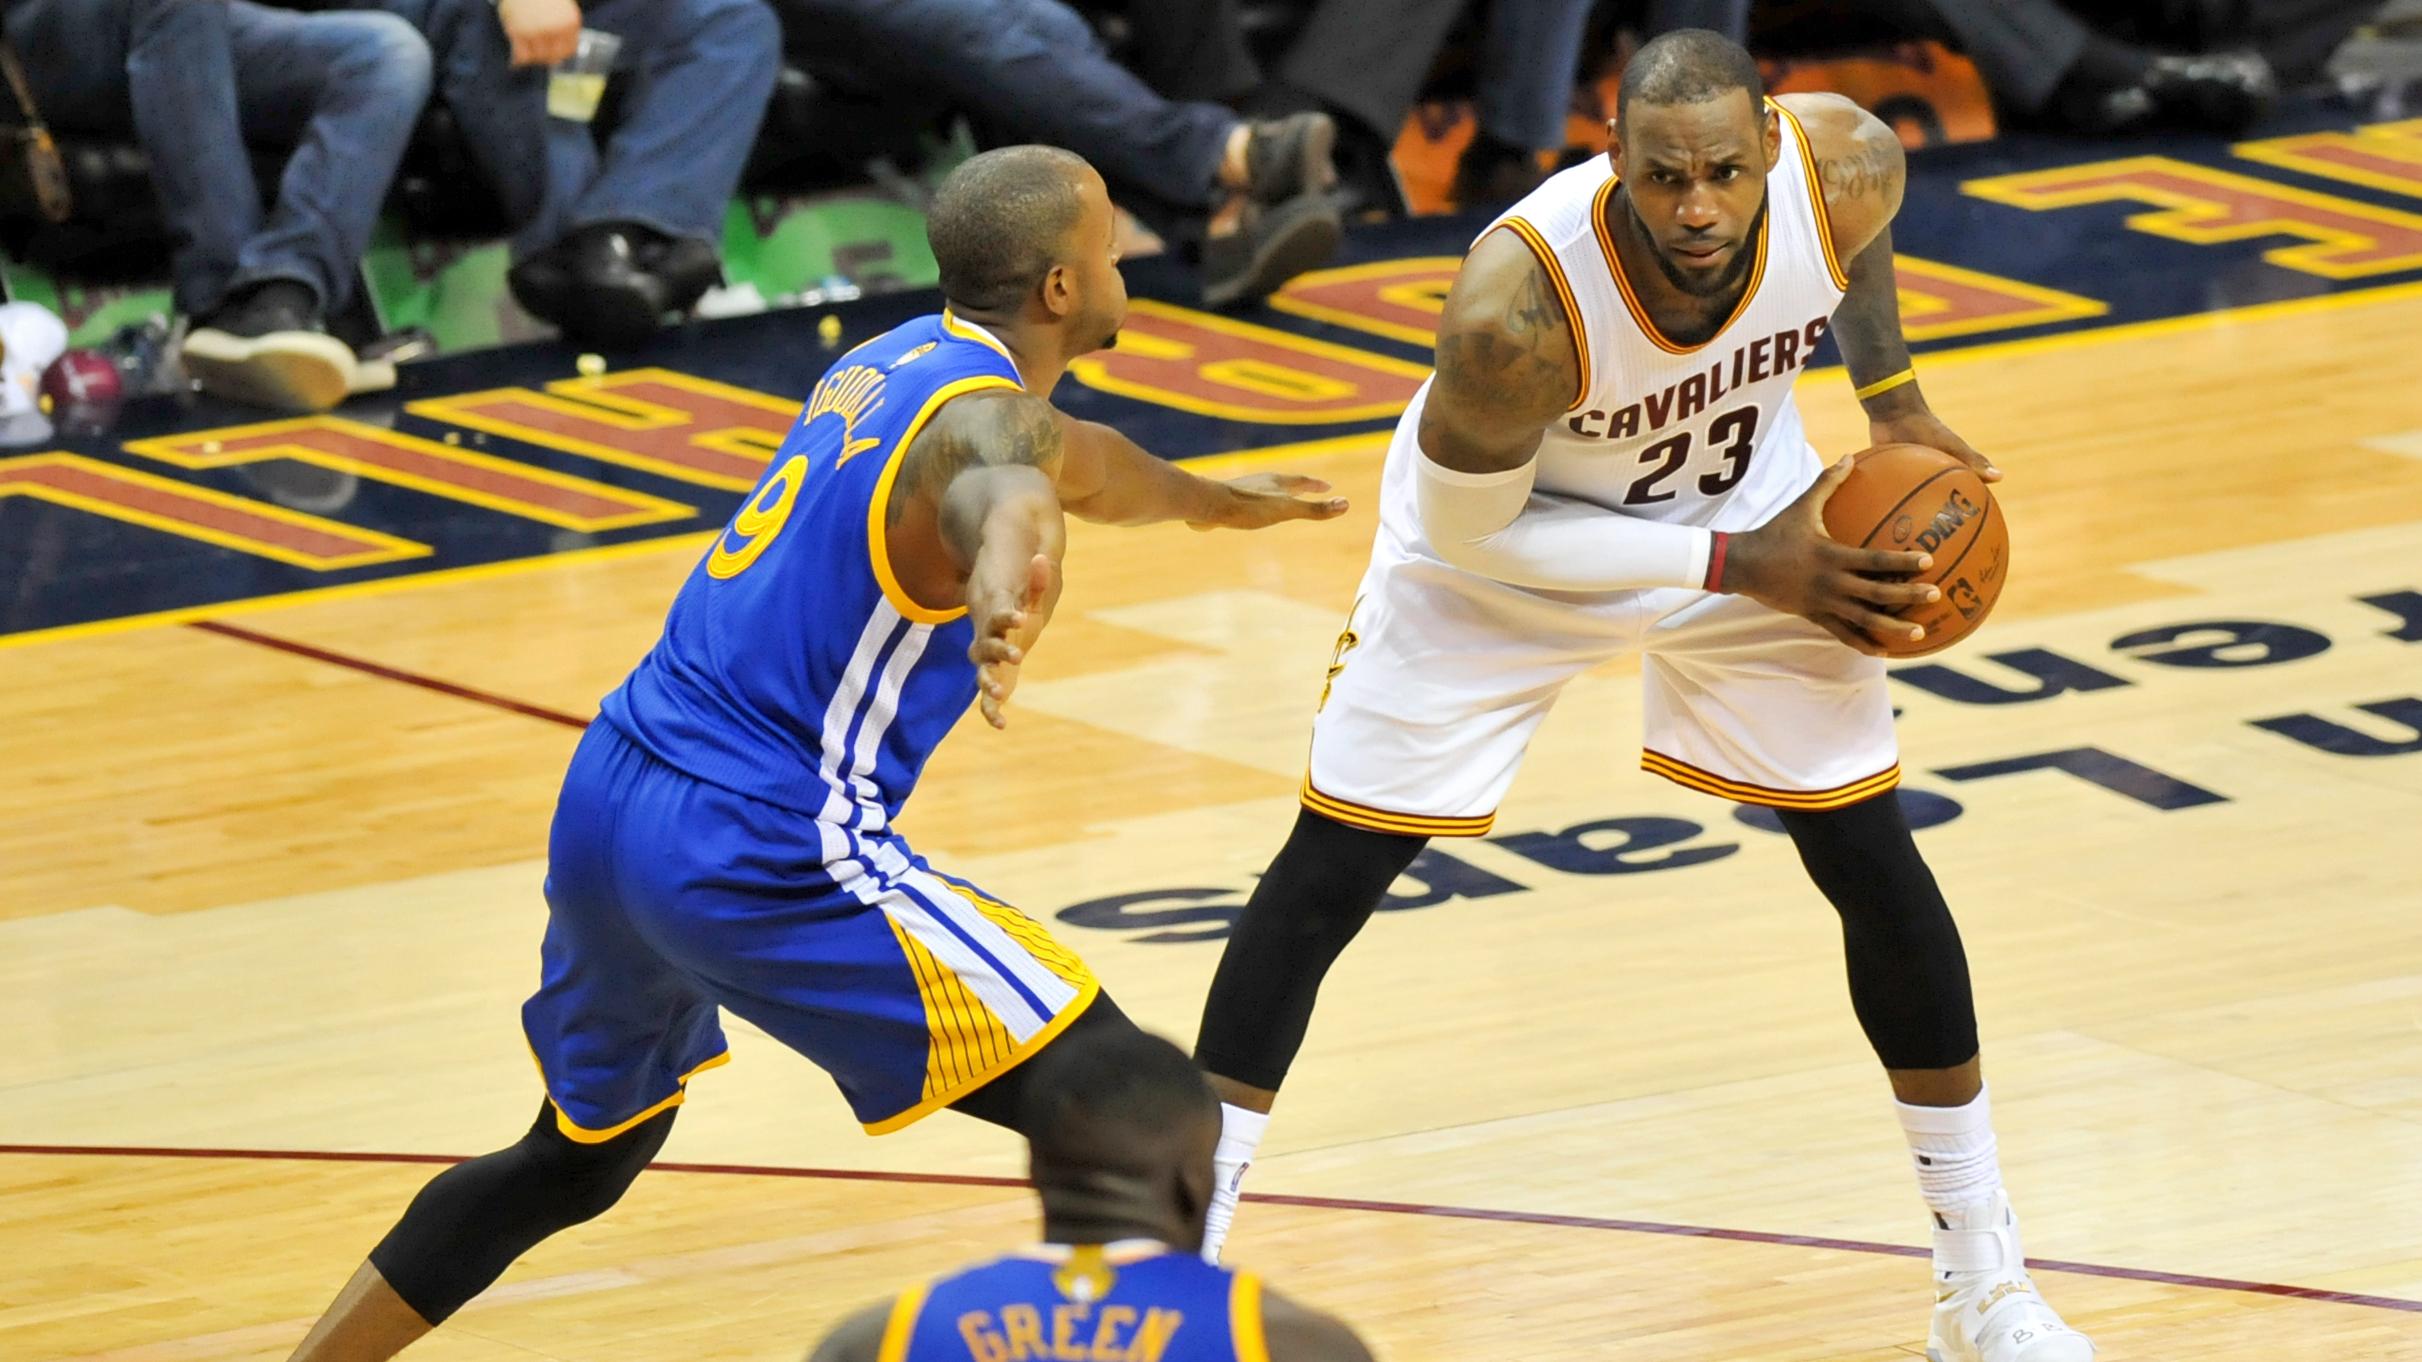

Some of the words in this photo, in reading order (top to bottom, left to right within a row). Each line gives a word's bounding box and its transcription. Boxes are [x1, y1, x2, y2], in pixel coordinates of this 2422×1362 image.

[1568, 315, 1829, 439] CAVALIERS
[1622, 404, 1760, 505] 23
[706, 454, 809, 579] 9
[1903, 487, 1982, 555] DING
[956, 1302, 1184, 1362] GREEN
